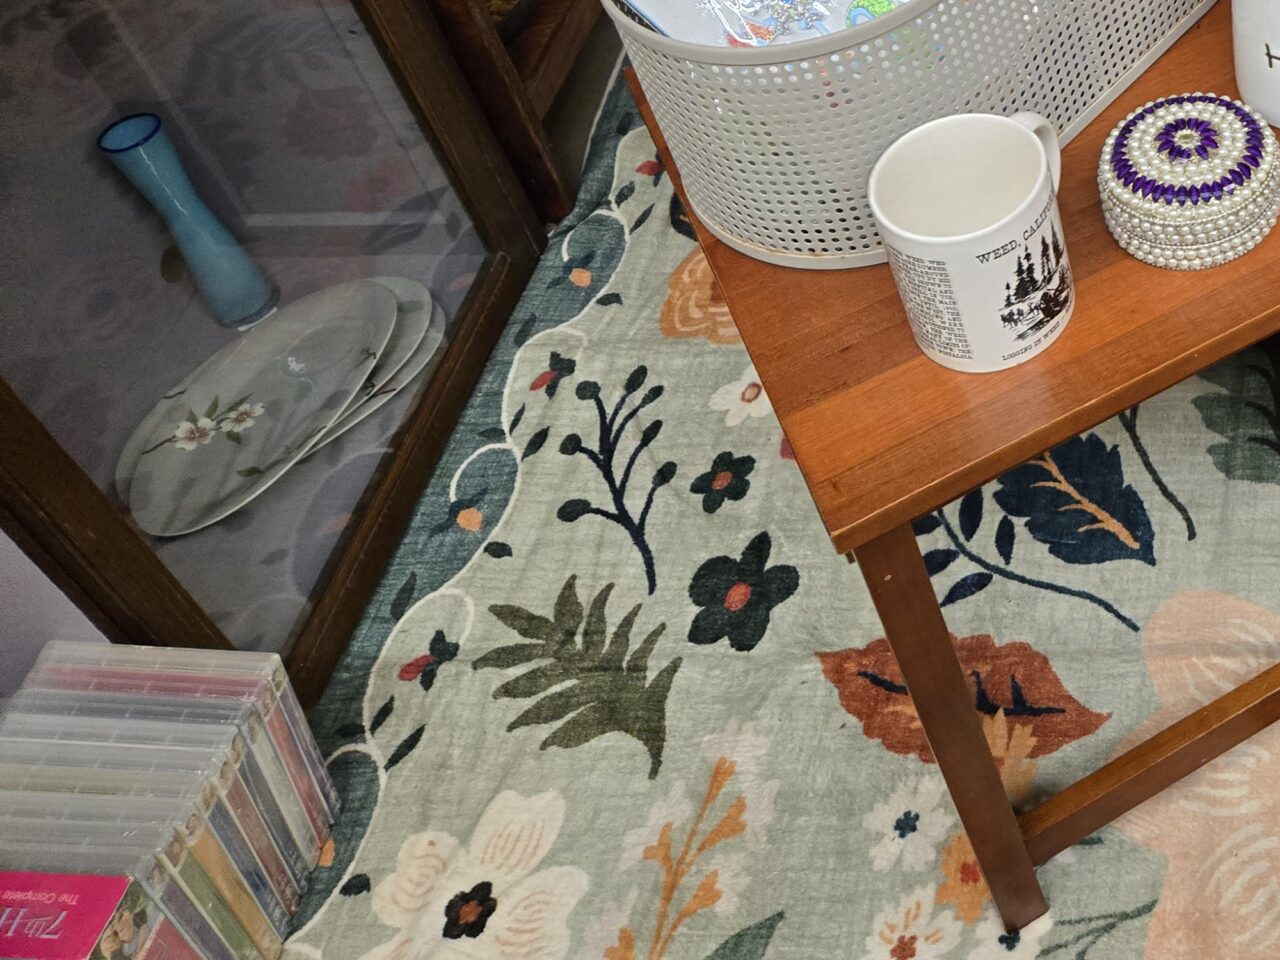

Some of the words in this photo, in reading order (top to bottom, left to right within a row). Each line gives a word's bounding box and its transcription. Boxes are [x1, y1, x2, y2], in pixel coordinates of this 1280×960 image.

[1002, 344, 1033, 361] LOGGING
[3, 890, 56, 904] Complete
[59, 893, 80, 905] The
